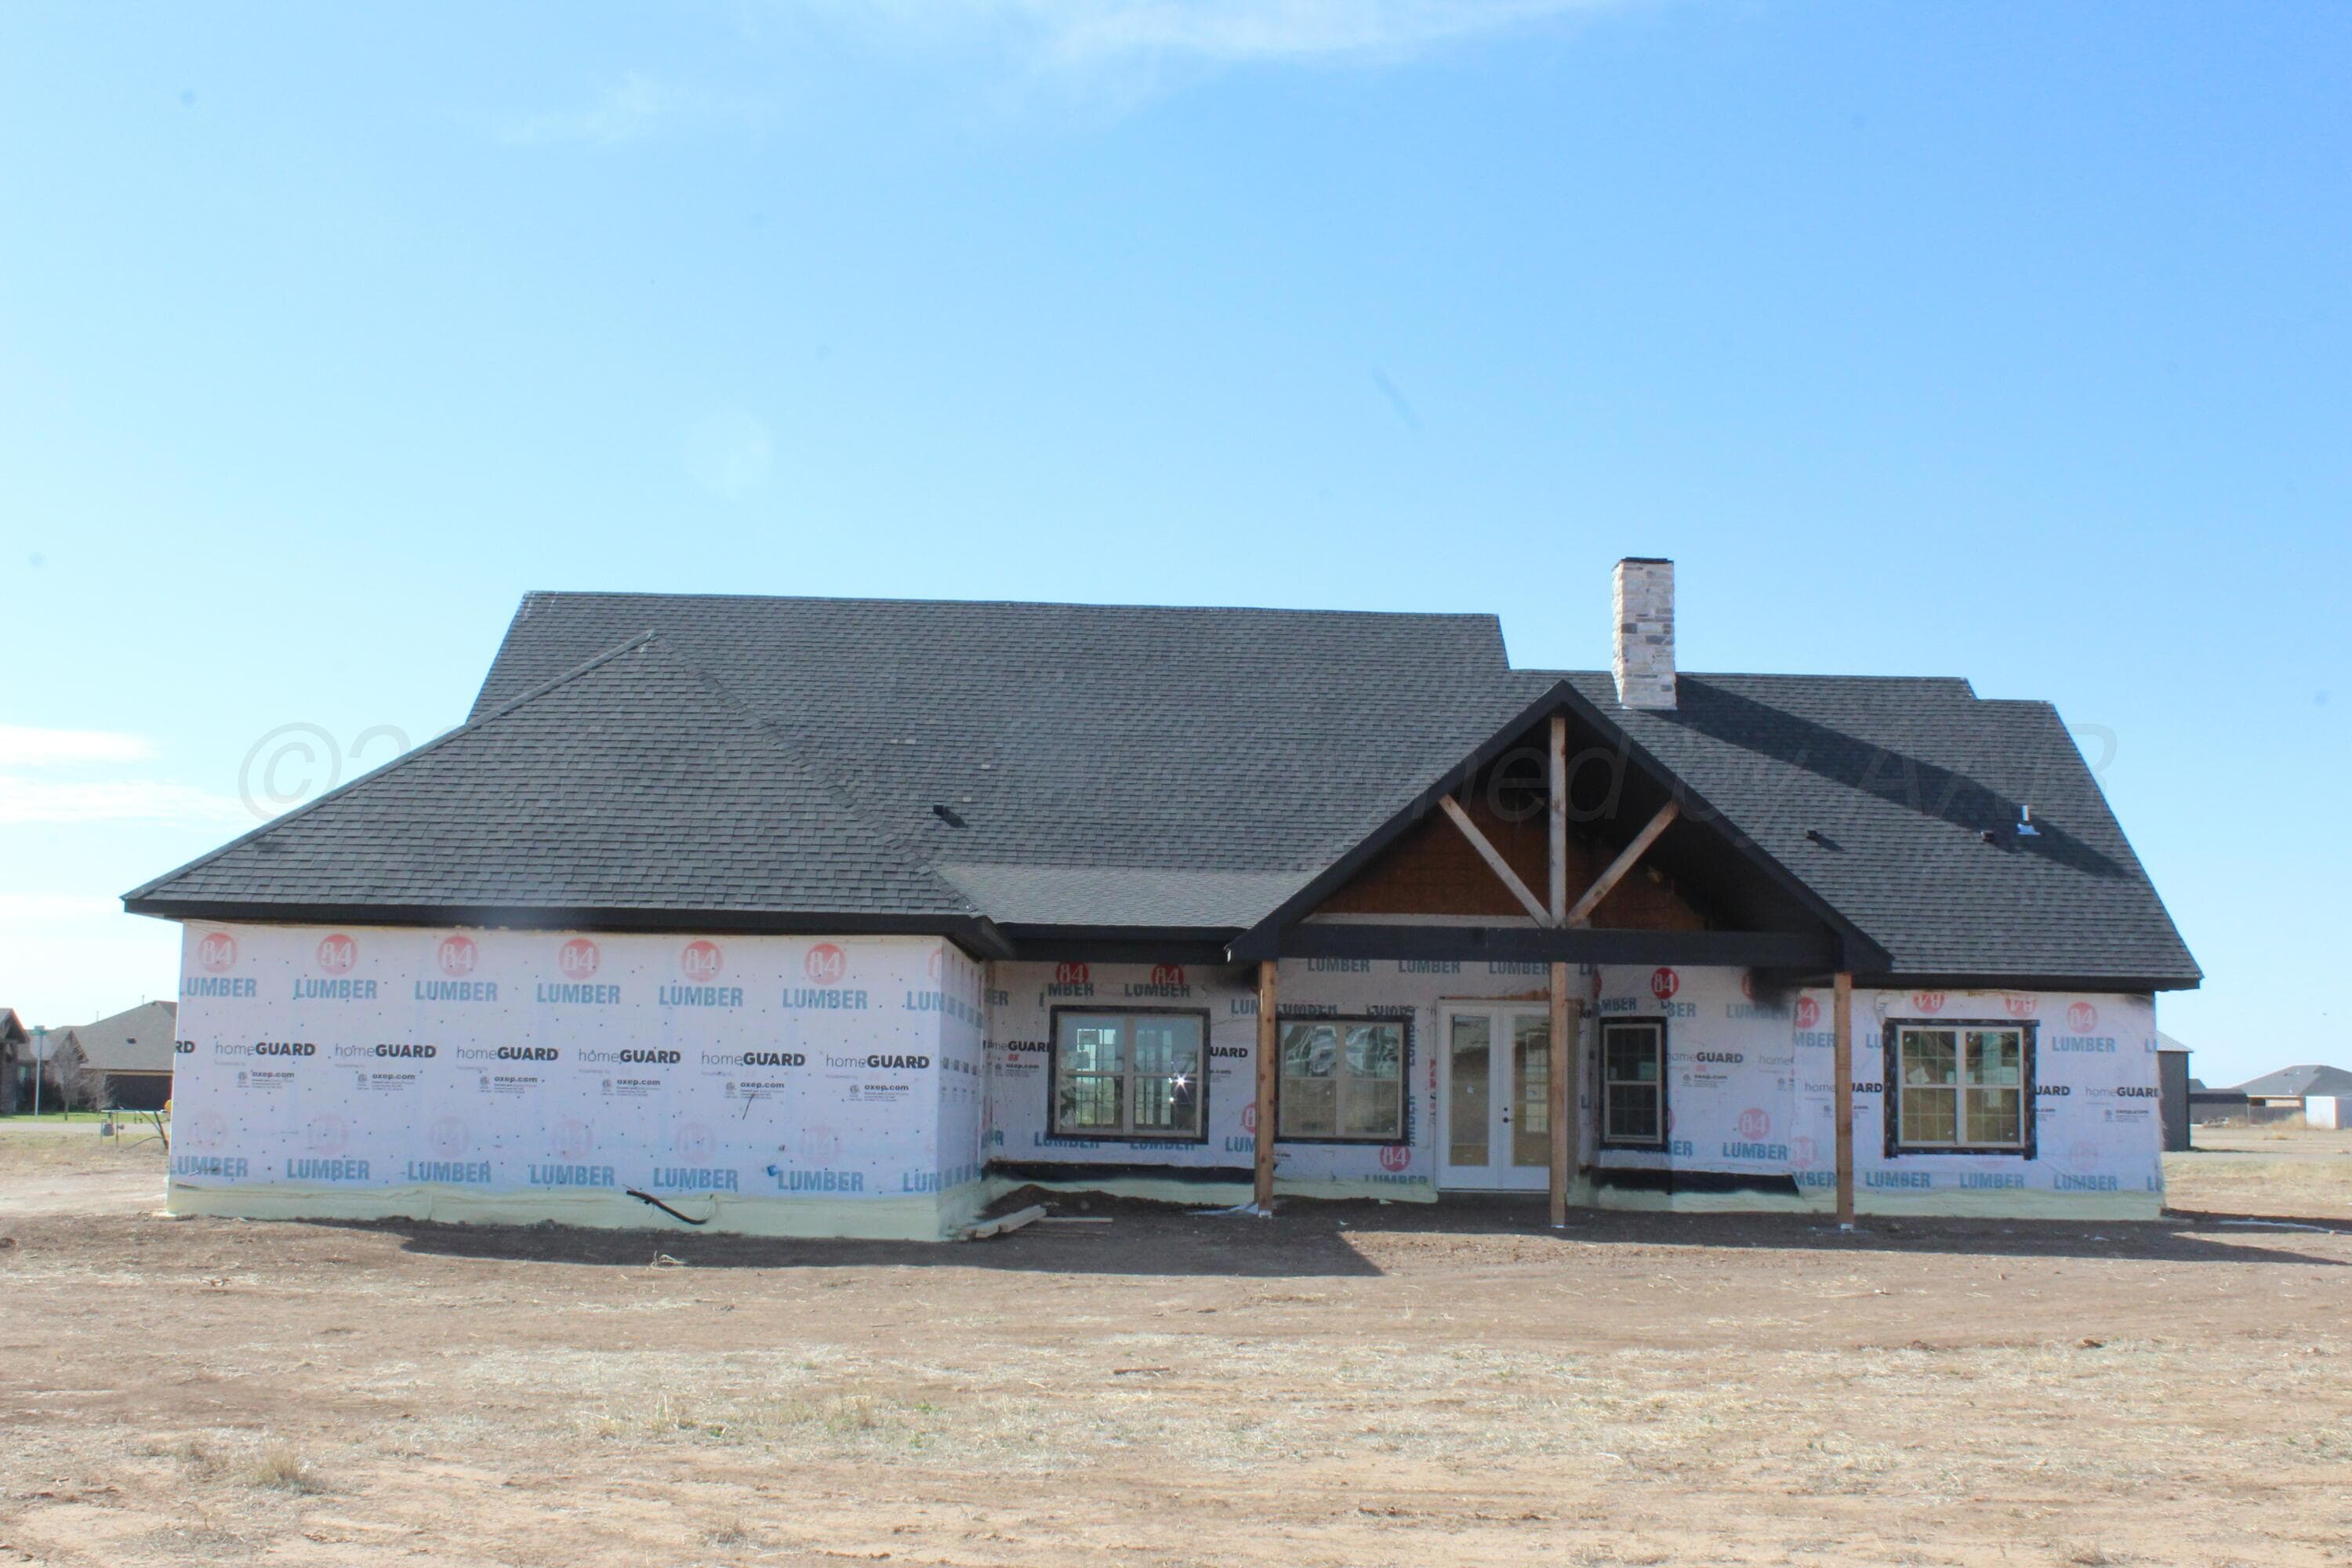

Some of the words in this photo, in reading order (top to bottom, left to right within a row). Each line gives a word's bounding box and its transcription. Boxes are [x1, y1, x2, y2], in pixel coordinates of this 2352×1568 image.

[318, 942, 352, 967] 84
[440, 945, 473, 969] 84
[561, 946, 597, 972] 84
[684, 947, 719, 974] 84
[808, 949, 842, 976] 84
[1060, 964, 1083, 982] 84
[1308, 958, 1370, 972] LUMBER
[1398, 960, 1461, 973] LUMBER
[180, 978, 257, 997] UMBER
[294, 979, 378, 1000] LUMBER
[414, 980, 499, 1003] LUMBER
[536, 983, 621, 1004] LUMBER
[659, 985, 743, 1007] LUMBER
[1048, 983, 1094, 996] MBER
[1124, 984, 1190, 996] LUMBER
[782, 989, 868, 1010] LUMBER
[2069, 1009, 2095, 1027] 84
[215, 1041, 316, 1056] homeGUARD
[1794, 1033, 1836, 1047] MBER
[2053, 1036, 2115, 1052] LUMBER
[335, 1044, 437, 1058] homeGUARD
[456, 1045, 559, 1061] homeGUARD
[579, 1048, 681, 1064] homeGUARD
[701, 1051, 805, 1066] homeGUARD
[826, 1054, 930, 1069] homeGUARD
[1742, 1114, 1766, 1133] 84
[1383, 1147, 1406, 1165] 84
[1723, 1142, 1788, 1160] LUMBER
[287, 1159, 370, 1180] LUMBER
[408, 1160, 491, 1183] LUMBER
[530, 1164, 615, 1186] LUMBER
[654, 1167, 739, 1189] LUMBER
[778, 1171, 863, 1192] LUMBER
[1866, 1172, 1931, 1188] LUMBER
[1960, 1173, 2024, 1189] LUMBER
[2054, 1175, 2118, 1192] LUMBER
